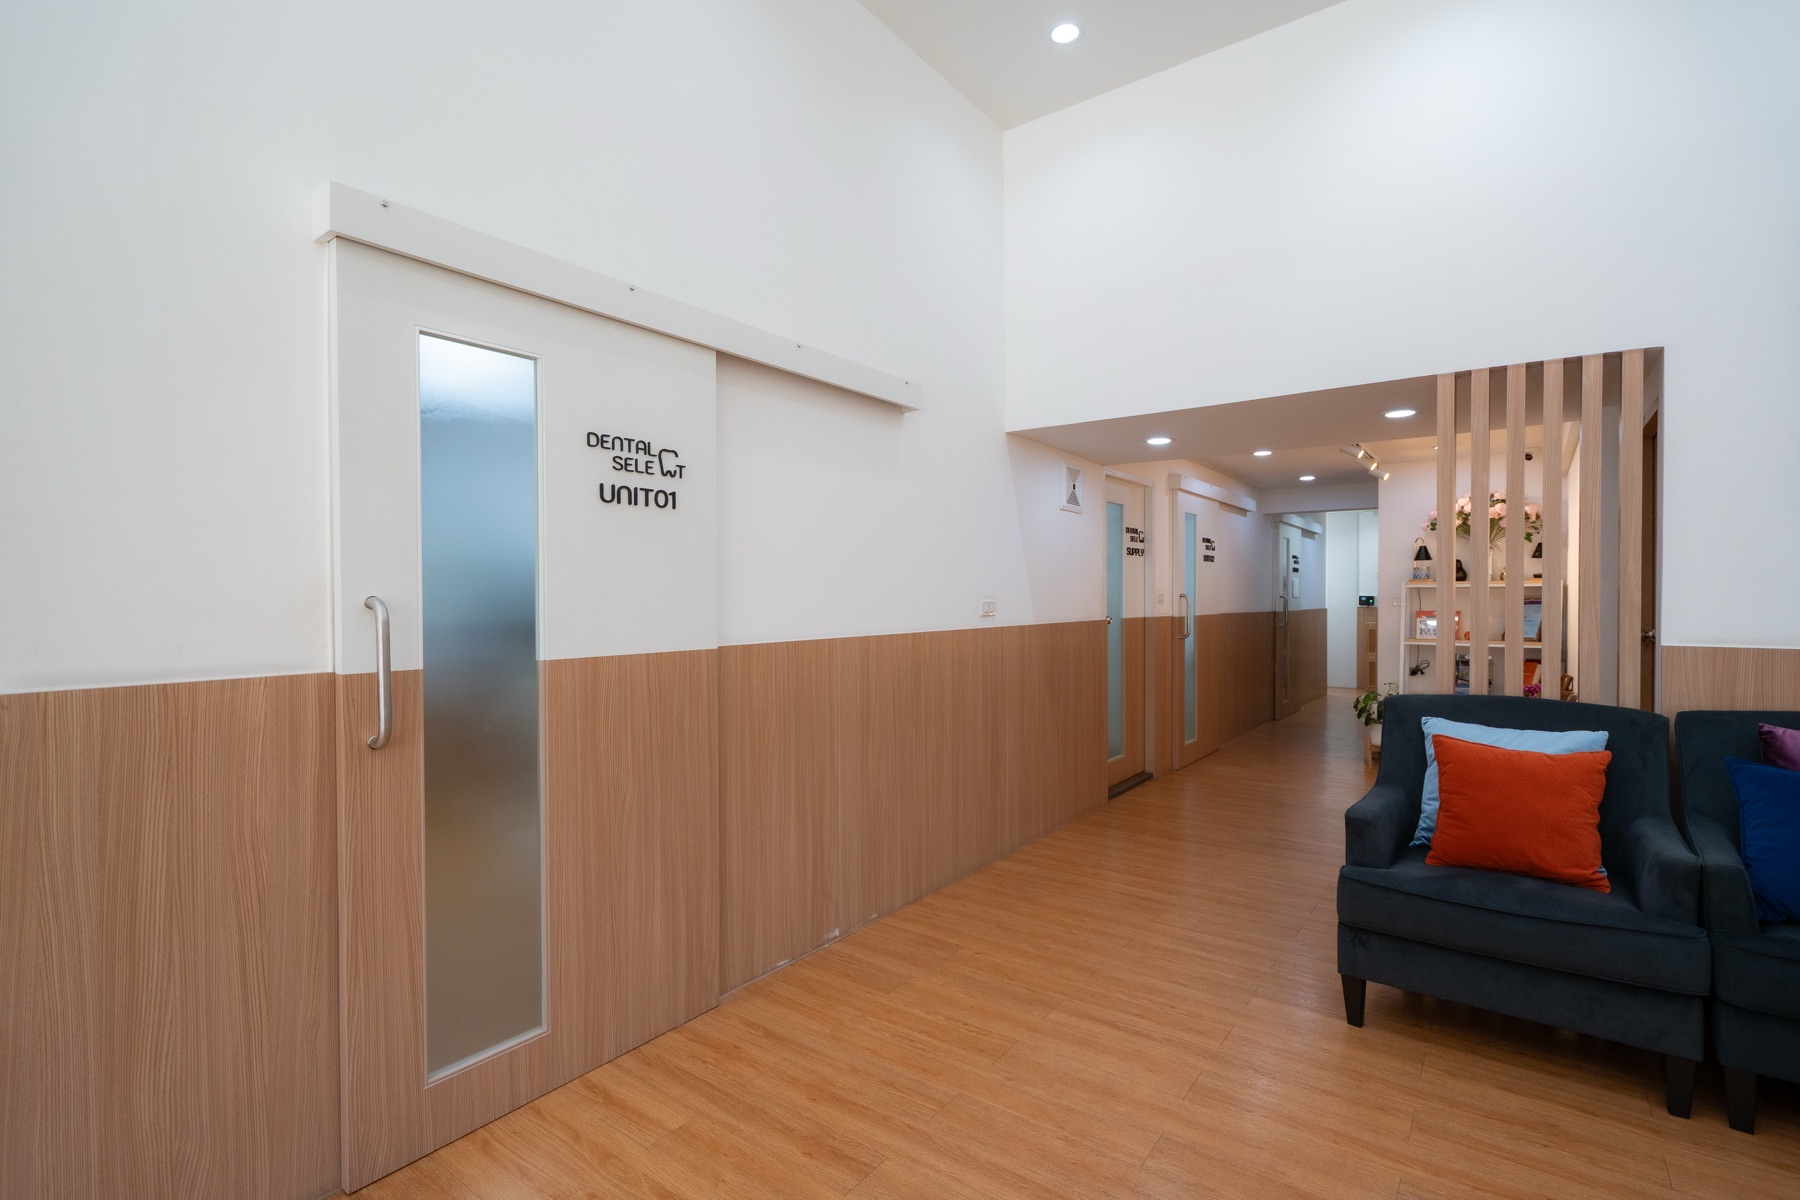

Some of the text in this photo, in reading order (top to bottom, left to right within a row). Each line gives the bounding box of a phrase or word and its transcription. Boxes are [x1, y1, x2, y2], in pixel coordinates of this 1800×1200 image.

[586, 431, 658, 457] DENTAL
[599, 482, 677, 510] UNIT01
[1126, 547, 1145, 557] SUPPLY
